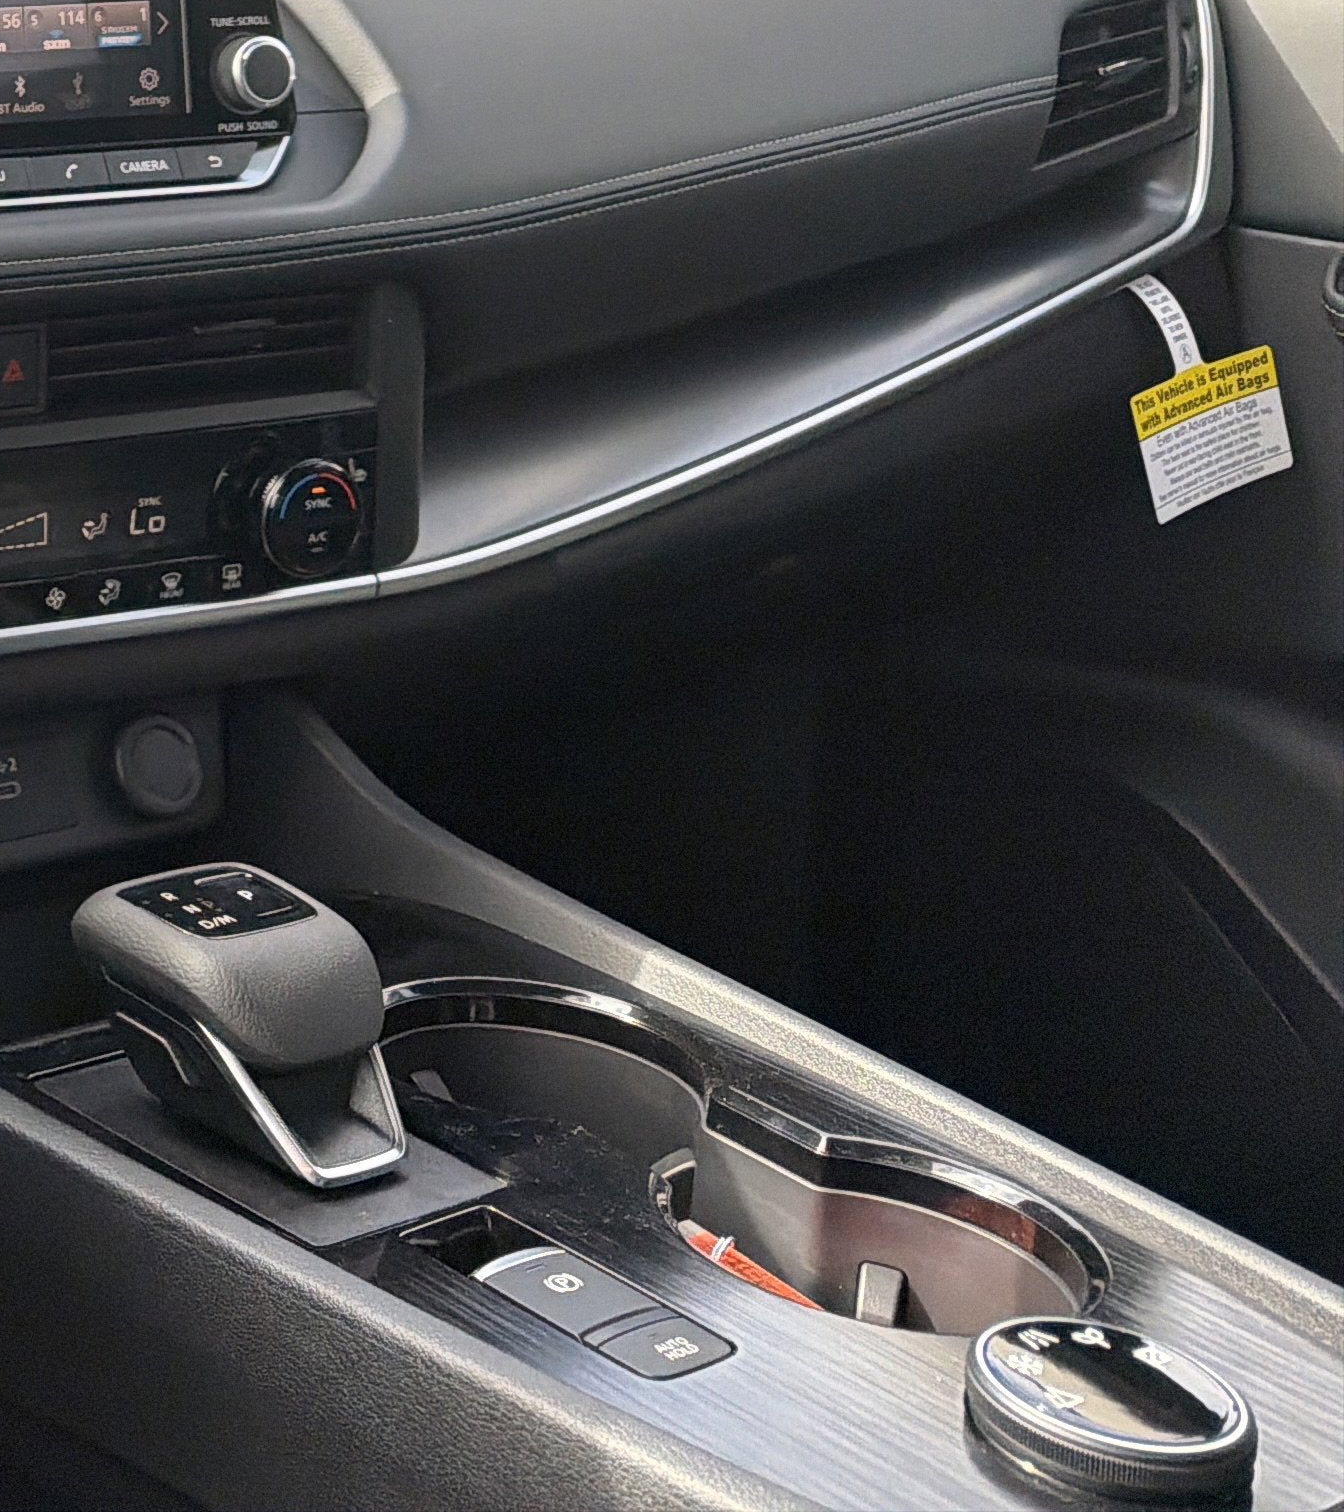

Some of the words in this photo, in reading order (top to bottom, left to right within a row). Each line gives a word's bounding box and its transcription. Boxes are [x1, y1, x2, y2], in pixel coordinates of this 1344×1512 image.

[2, 13, 23, 30] 56
[29, 14, 39, 27] 5
[58, 9, 86, 26] 114
[94, 10, 103, 23] 6
[139, 7, 148, 22] 1
[13, 101, 46, 114] Audio
[128, 94, 171, 108] Settings
[218, 122, 244, 133] PUSH
[246, 120, 279, 132] SOUND
[119, 158, 170, 174] CAMERA
[1134, 394, 1156, 415] This
[1156, 376, 1195, 403] Vehicle
[1196, 373, 1207, 387] is
[1208, 349, 1270, 383] Equipped
[1140, 413, 1162, 433] with
[1163, 388, 1212, 423] Advanced
[1216, 381, 1234, 399] Air
[1236, 371, 1270, 392] Bags
[304, 496, 333, 511] SYNC
[159, 891, 180, 903] R
[236, 890, 254, 901] P
[181, 903, 203, 915] N
[197, 914, 239, 930] D/M
[653, 1336, 690, 1354] AUTO
[663, 1343, 700, 1361] HOLD
